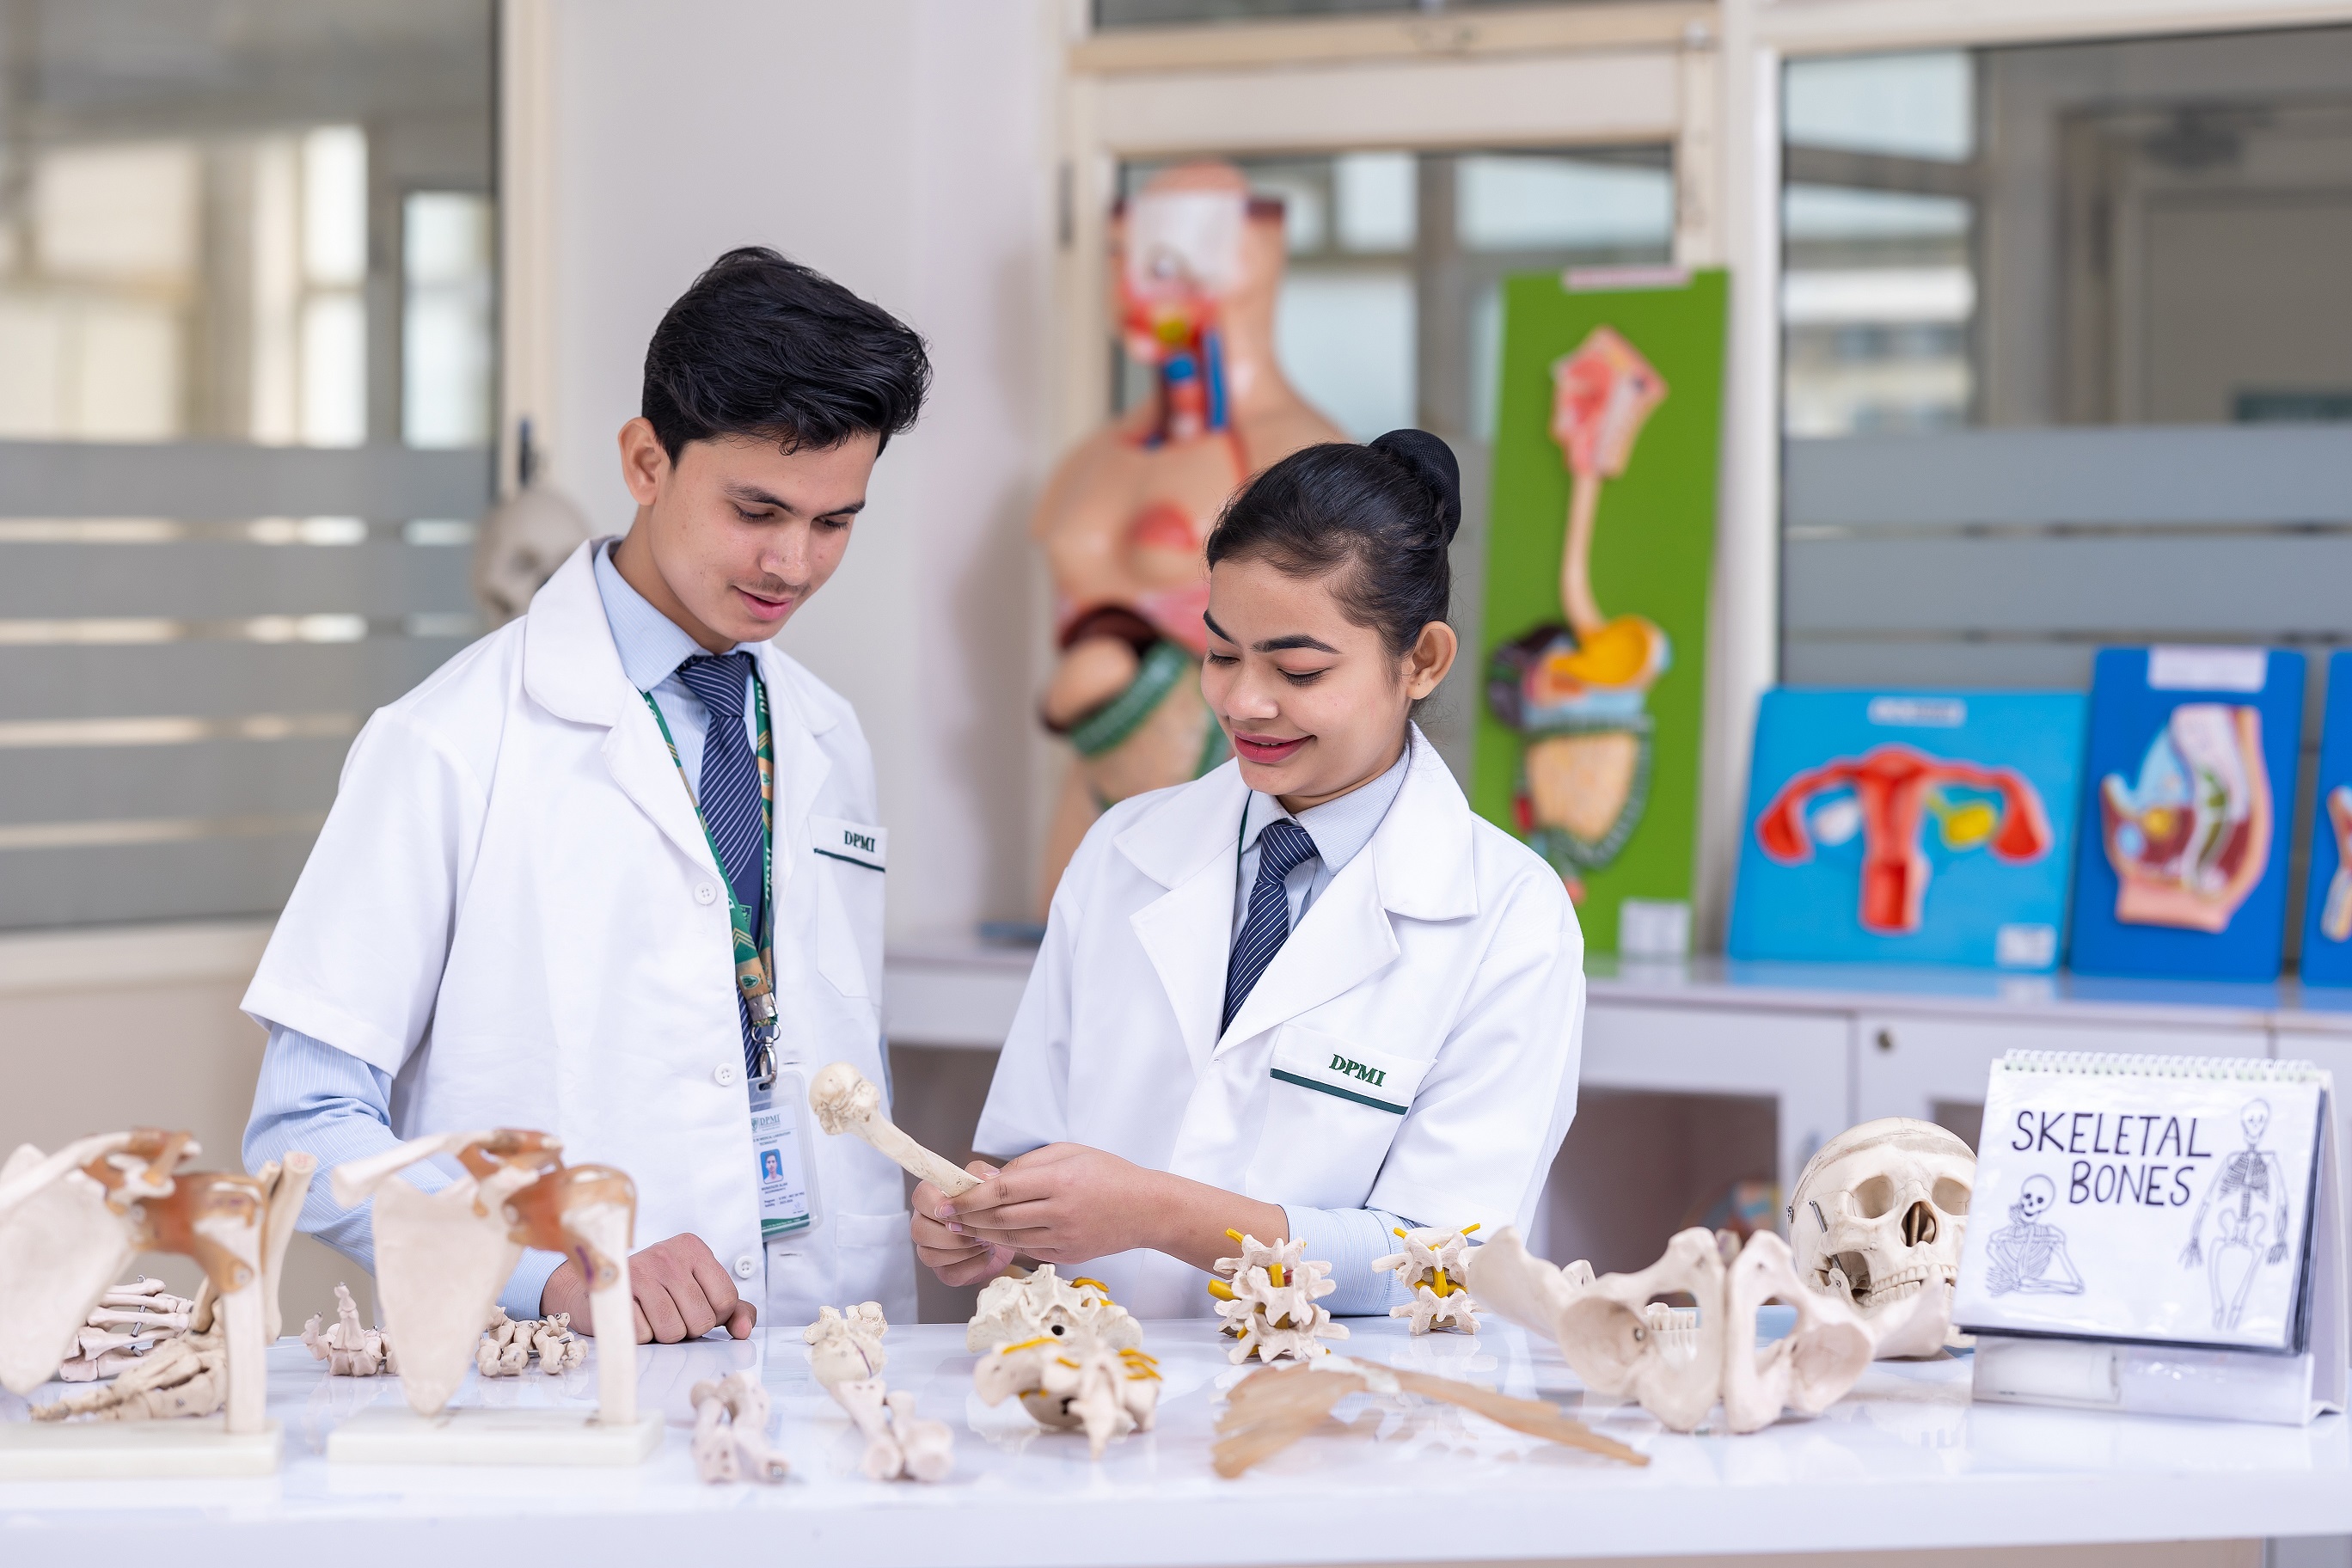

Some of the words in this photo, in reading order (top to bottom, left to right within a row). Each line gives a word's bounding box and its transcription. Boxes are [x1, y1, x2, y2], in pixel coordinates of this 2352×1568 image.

[844, 830, 876, 853] DPMI
[1329, 1054, 1386, 1087] DPMI
[760, 1114, 781, 1126] DPMI
[2012, 1110, 2212, 1157] SKELETAL
[2068, 1161, 2195, 1206] BONES
